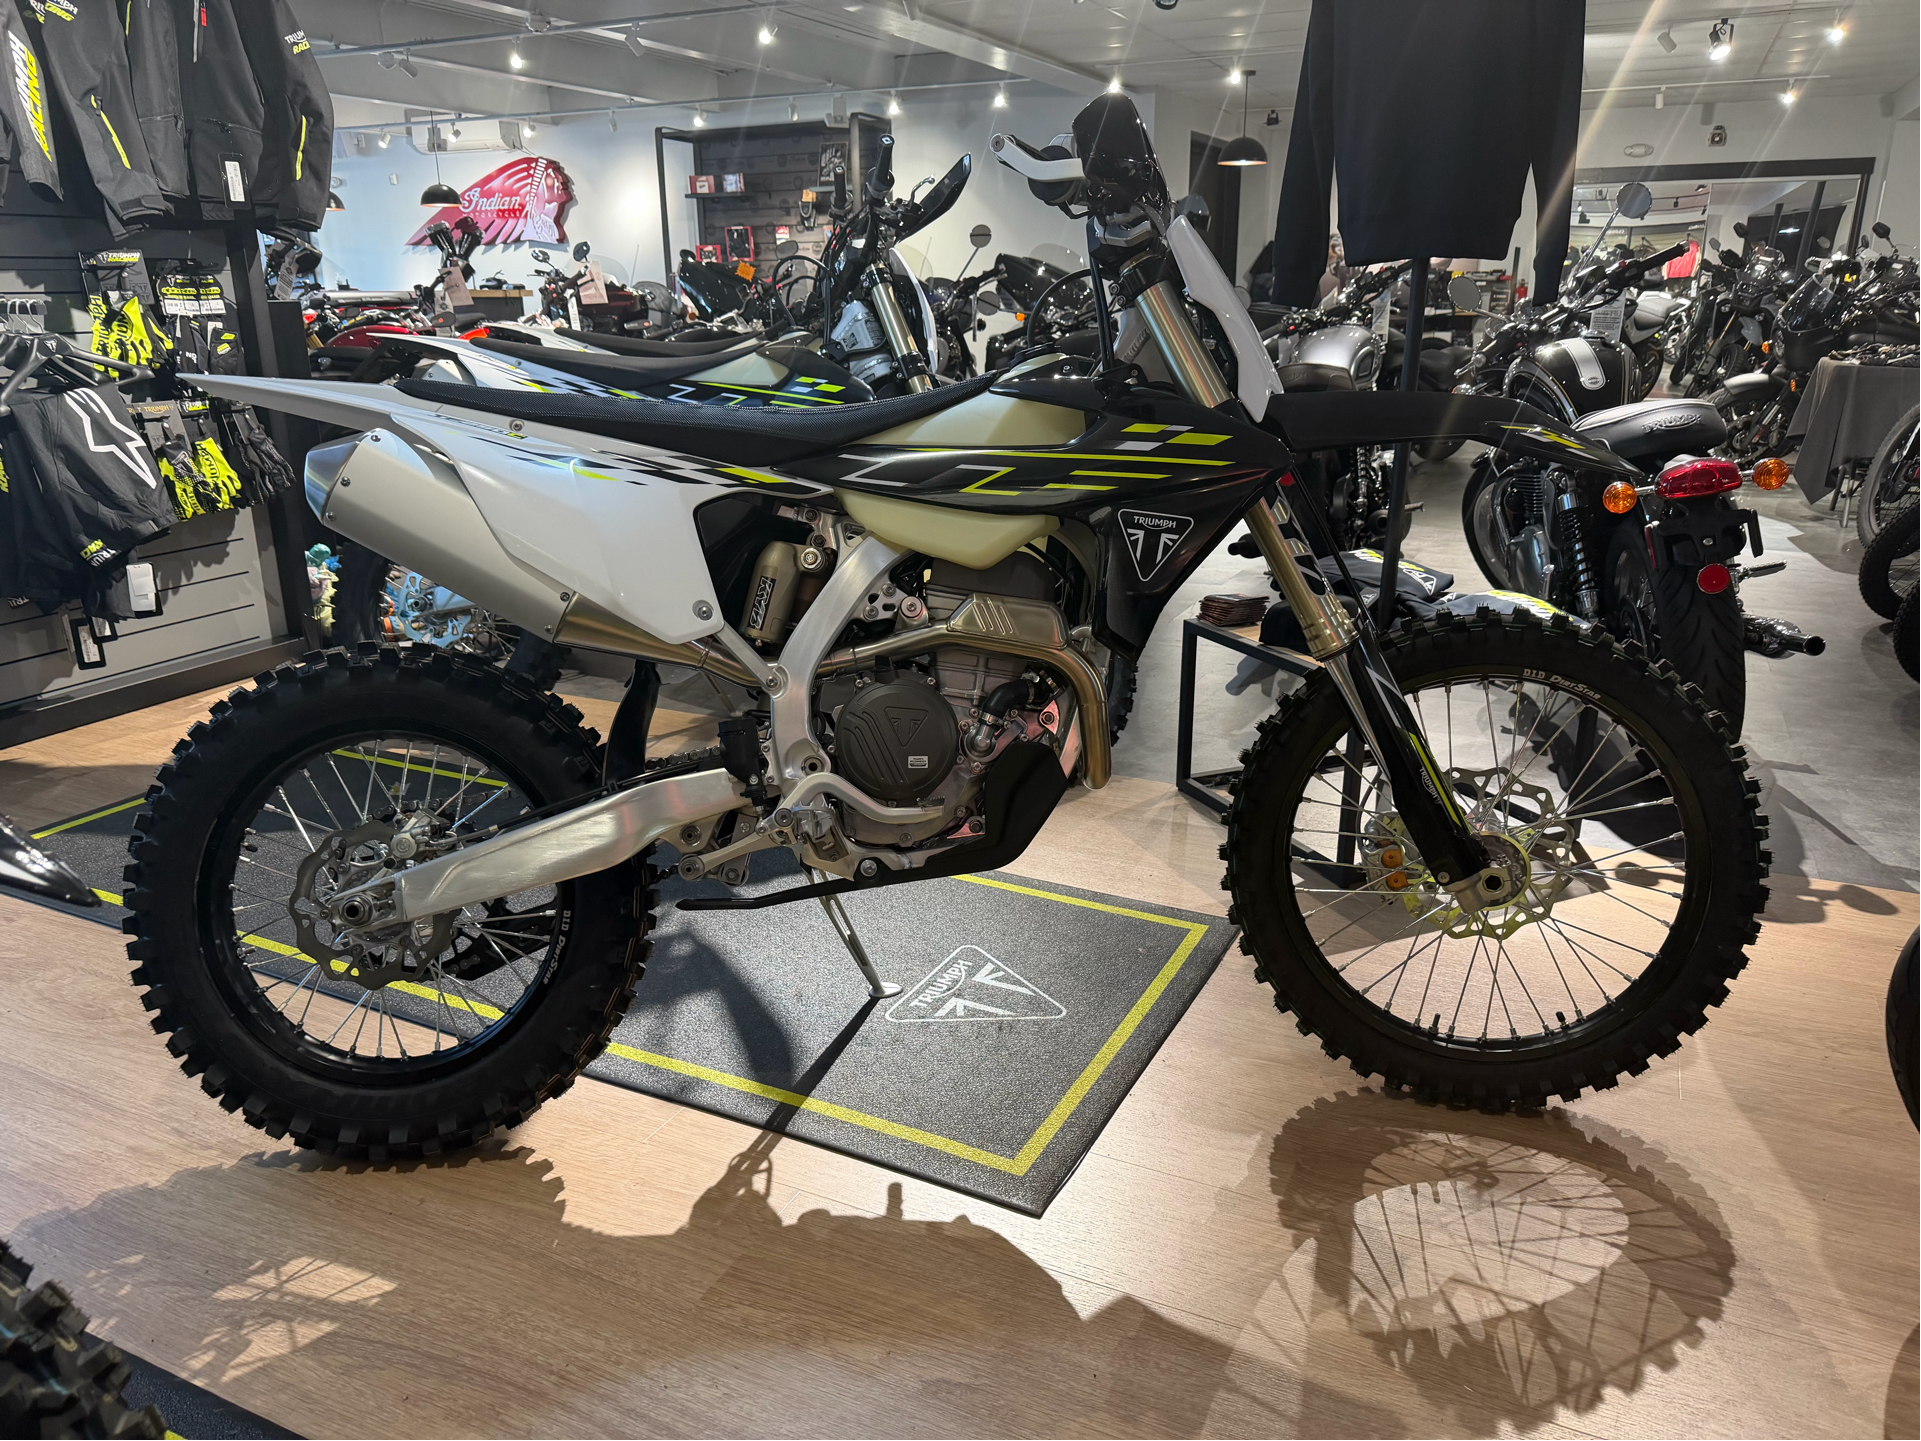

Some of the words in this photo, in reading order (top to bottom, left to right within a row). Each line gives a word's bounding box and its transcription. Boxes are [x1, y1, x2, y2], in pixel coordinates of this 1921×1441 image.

[459, 187, 522, 213] Indian
[1641, 413, 1703, 434] TRIUMPH
[1133, 515, 1177, 530] TRIUMPH
[749, 576, 773, 629] KYB
[1419, 766, 1439, 799] TRIUMPH
[908, 959, 973, 1008] TRIUMPH
